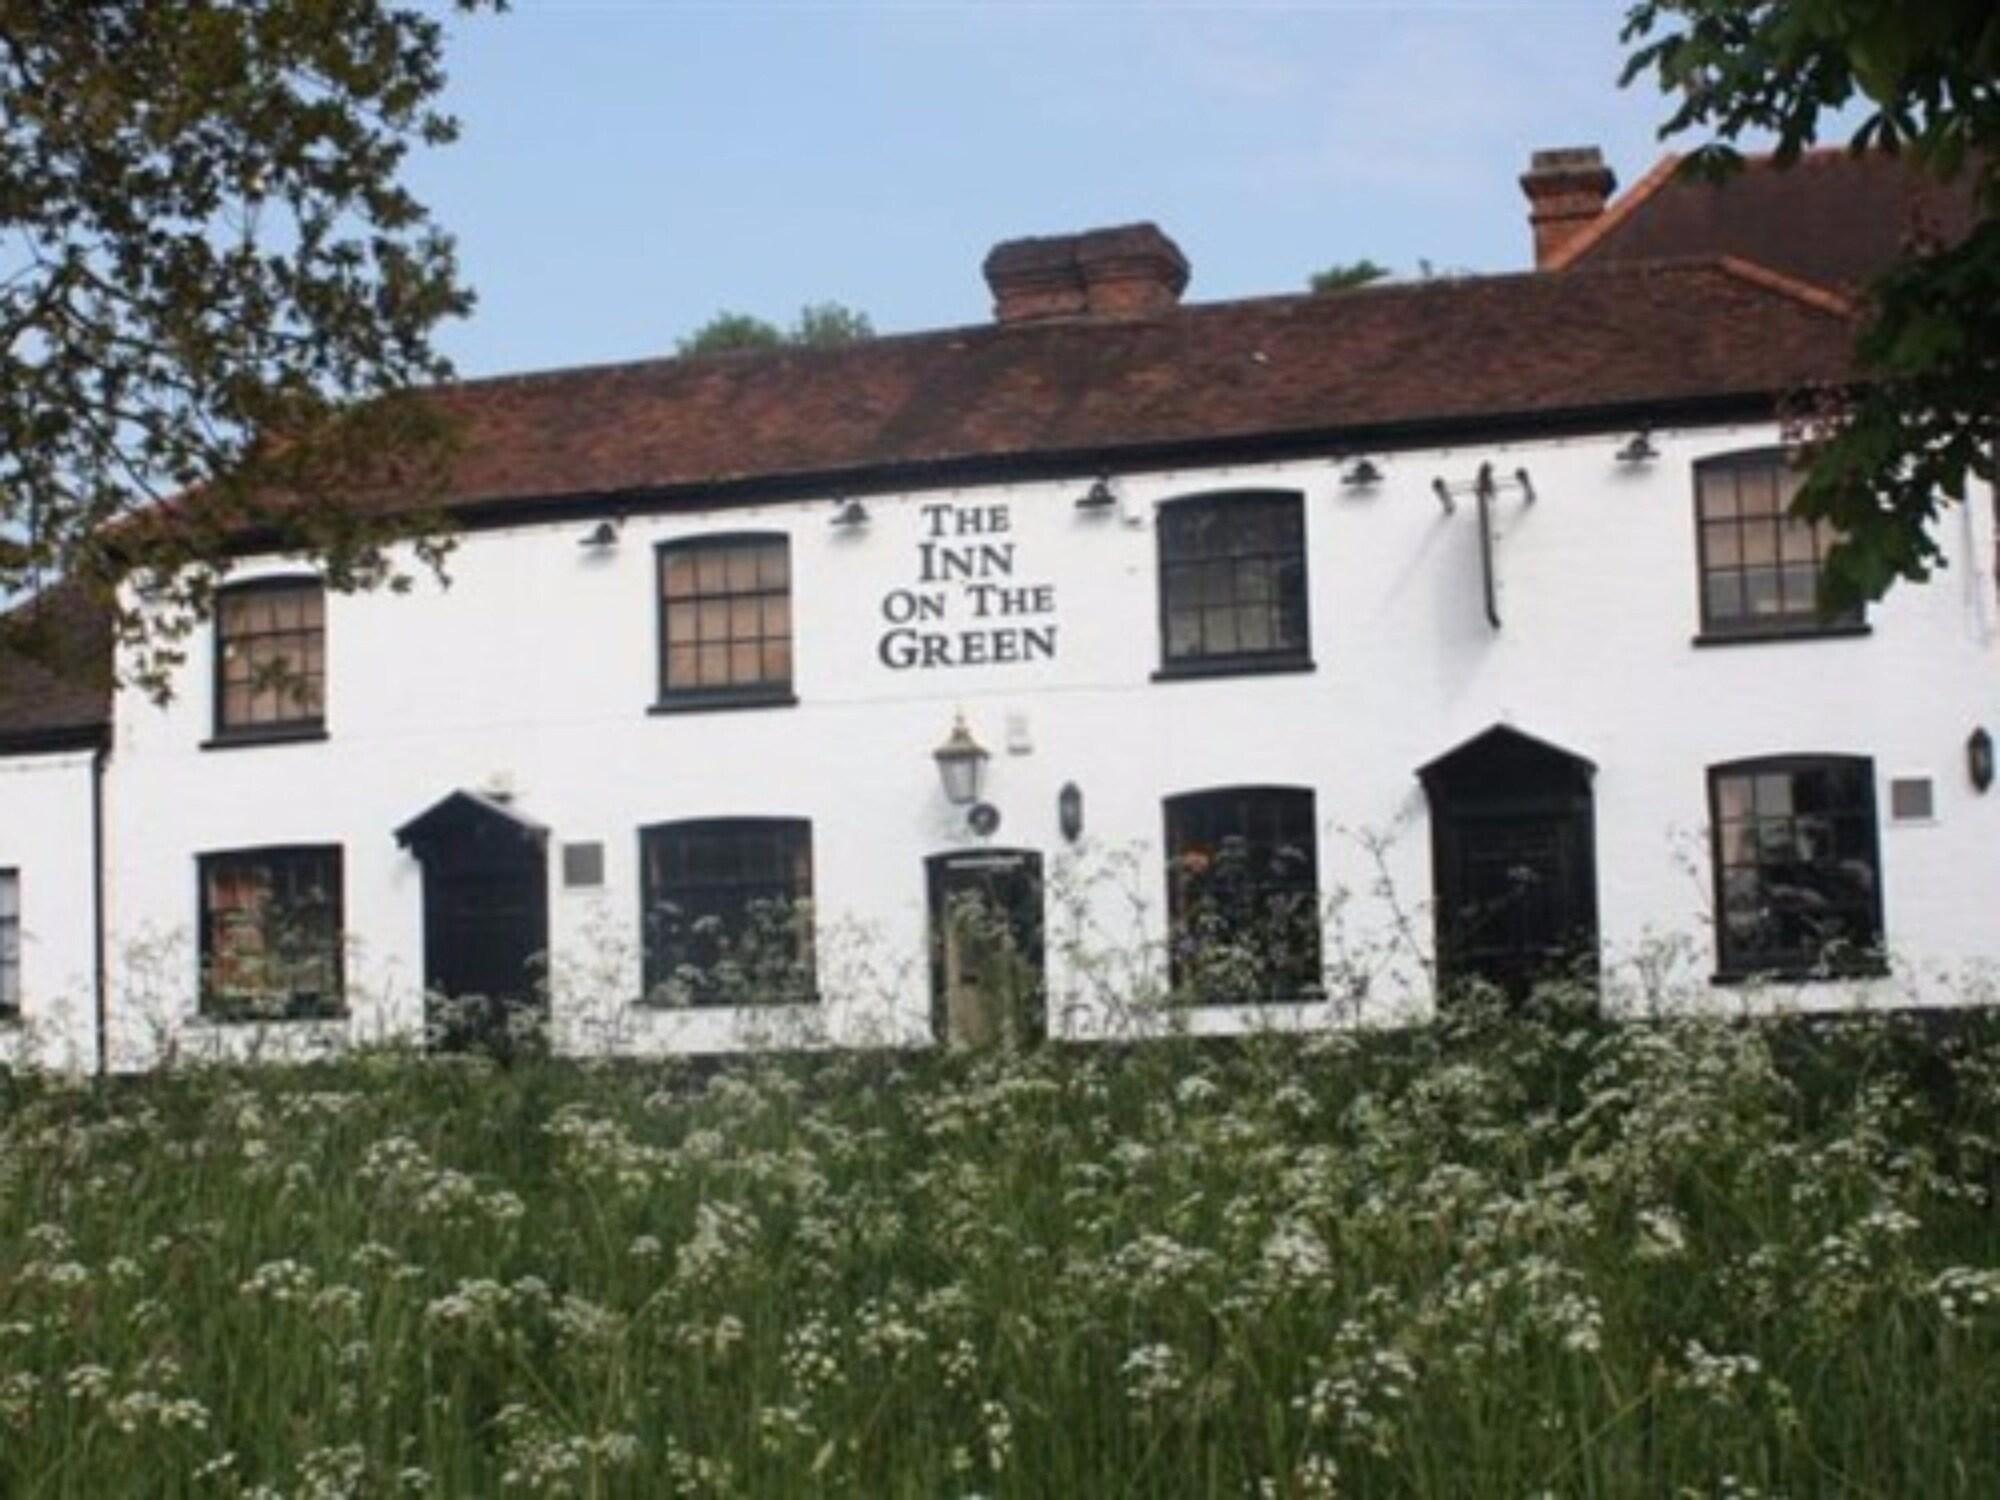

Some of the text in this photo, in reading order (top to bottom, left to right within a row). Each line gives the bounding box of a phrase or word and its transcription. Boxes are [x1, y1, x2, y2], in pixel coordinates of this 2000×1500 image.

[921, 503, 1010, 536] THE
[918, 543, 1015, 582] INN
[882, 583, 1056, 624] ON THE
[878, 625, 1057, 670] GREEN
